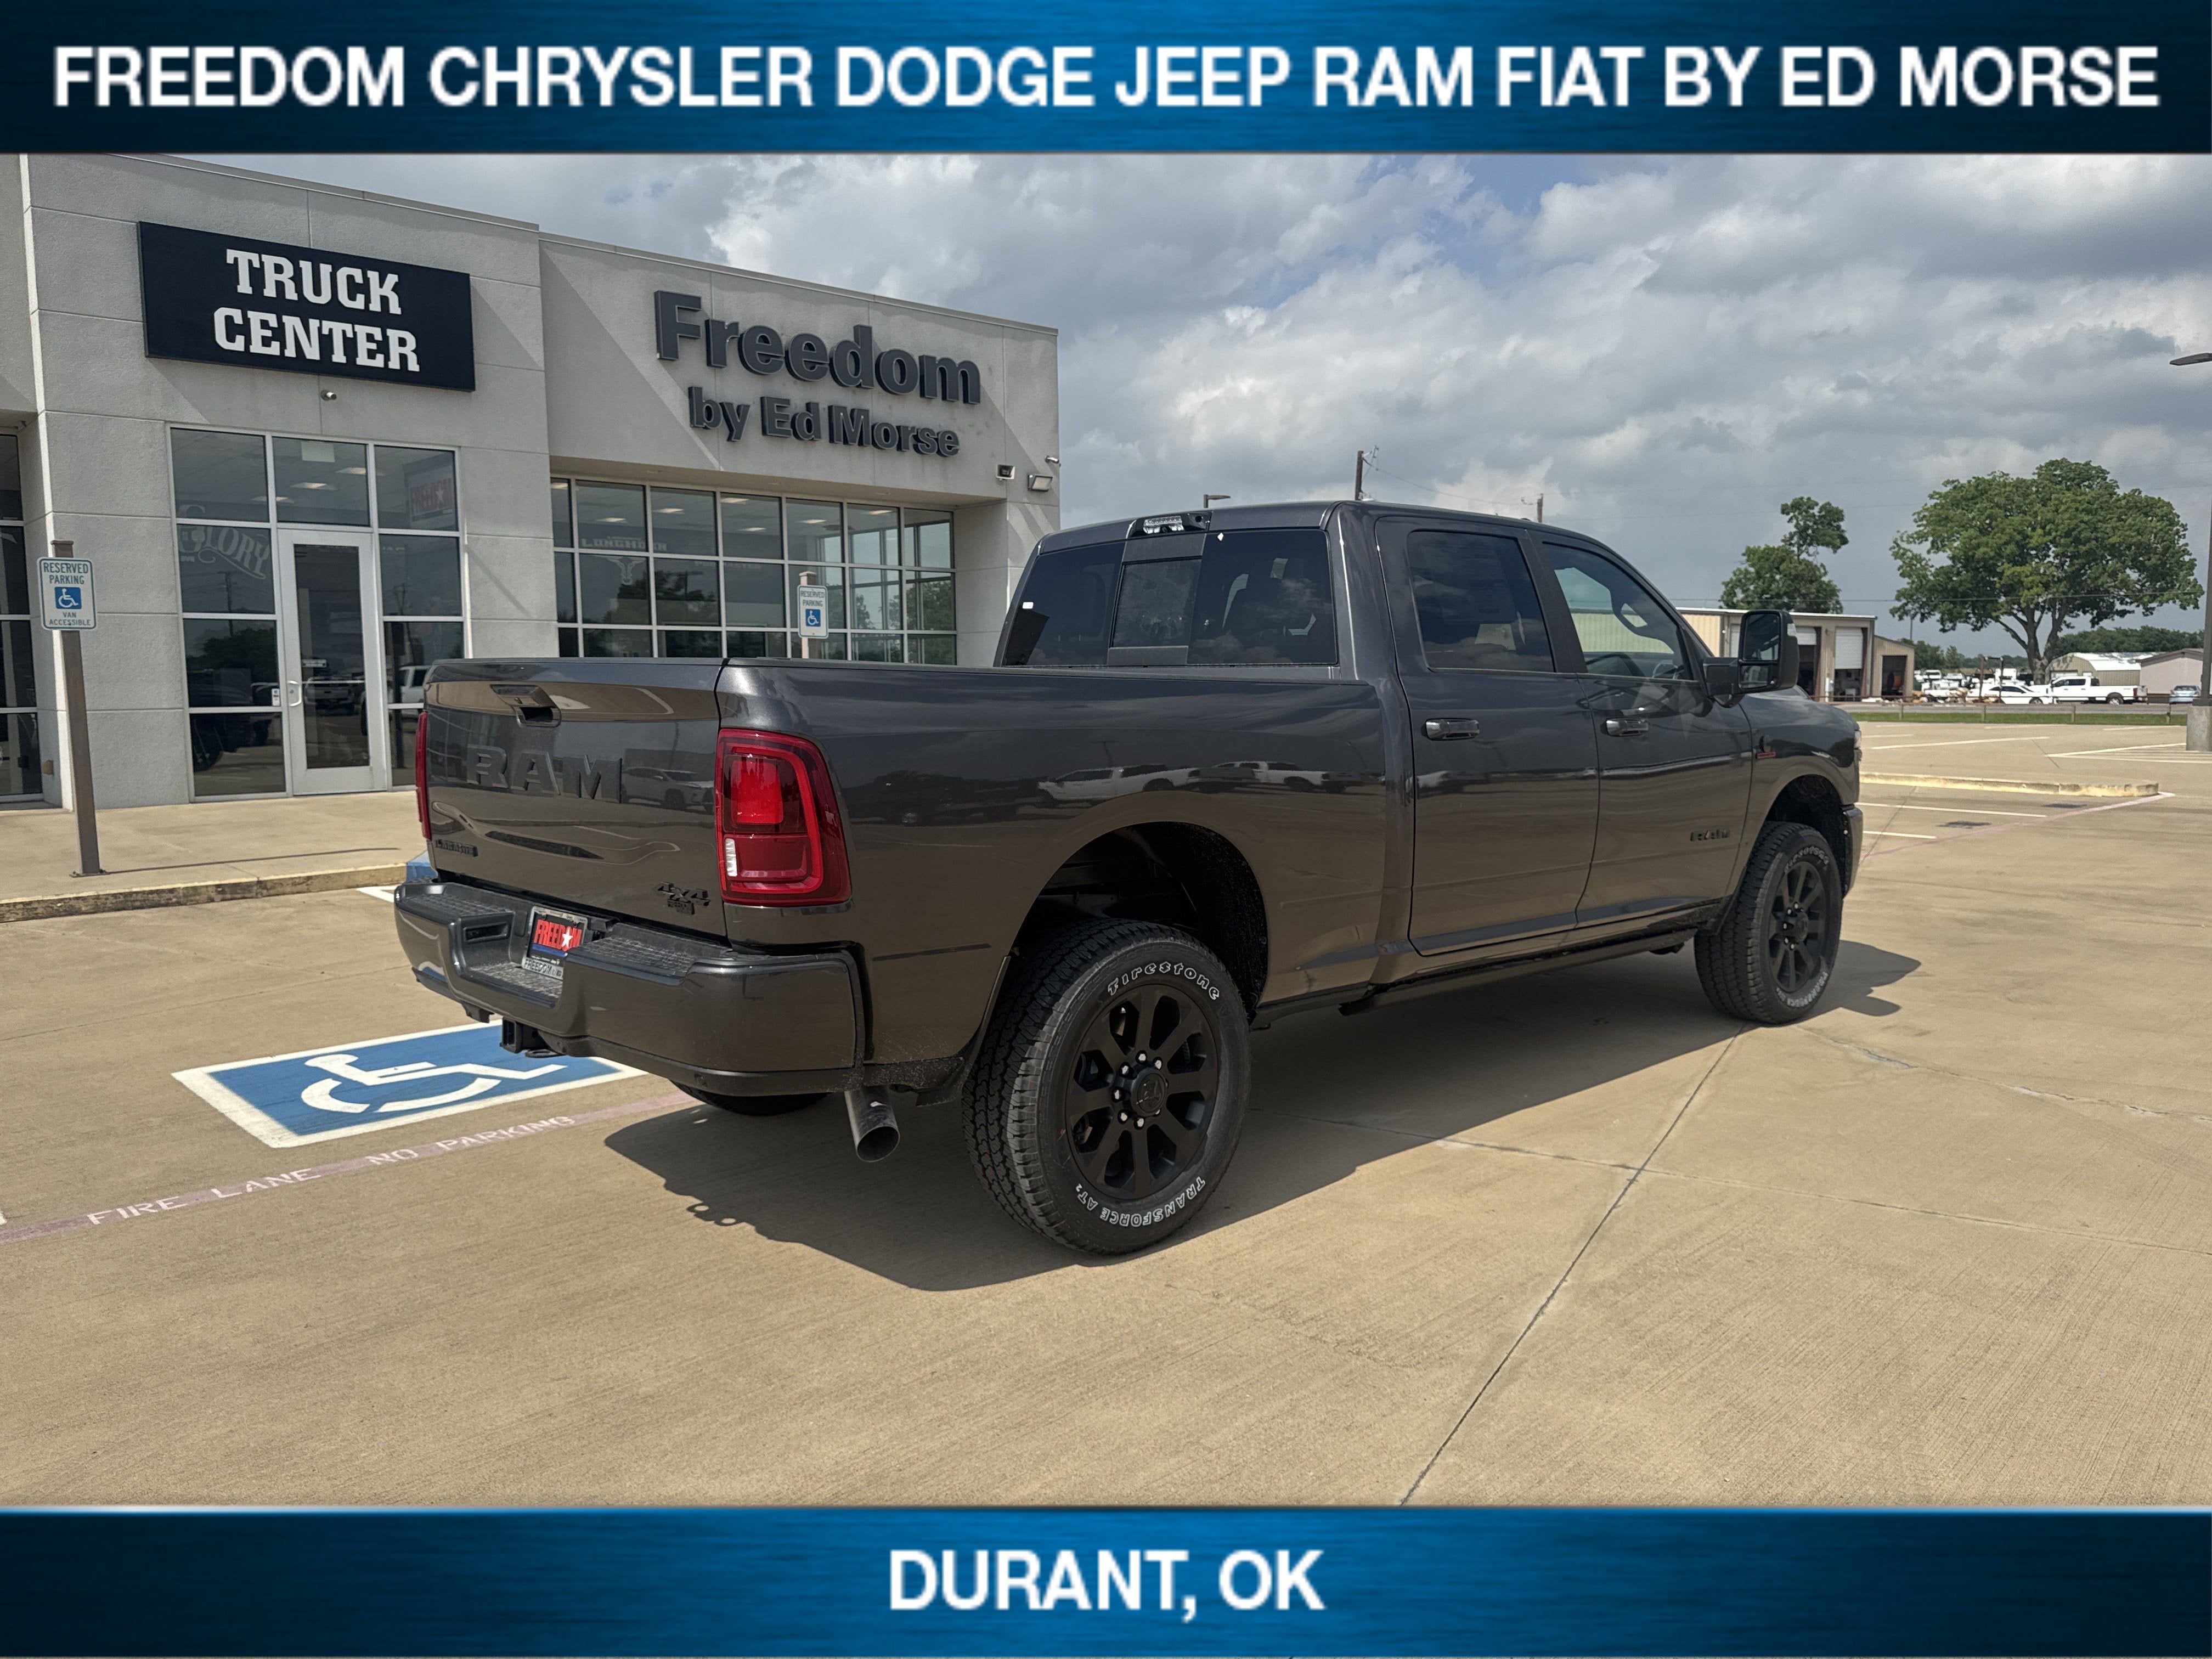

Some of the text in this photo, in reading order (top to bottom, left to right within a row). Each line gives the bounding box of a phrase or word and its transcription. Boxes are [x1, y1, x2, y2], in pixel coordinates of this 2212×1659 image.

[226, 249, 402, 315] TRUCK
[213, 306, 420, 373] CENTER
[654, 290, 981, 405] Freedom
[688, 386, 961, 458] by Ed Morse
[43, 562, 89, 574] RESERVED
[49, 574, 84, 585] PARKING
[466, 744, 623, 804] RAM
[1108, 961, 1220, 1000] Firestone
[86, 1115, 577, 1226] FIRE LANE NO PARKING
[1099, 1176, 1206, 1227] TRANSFORCE
